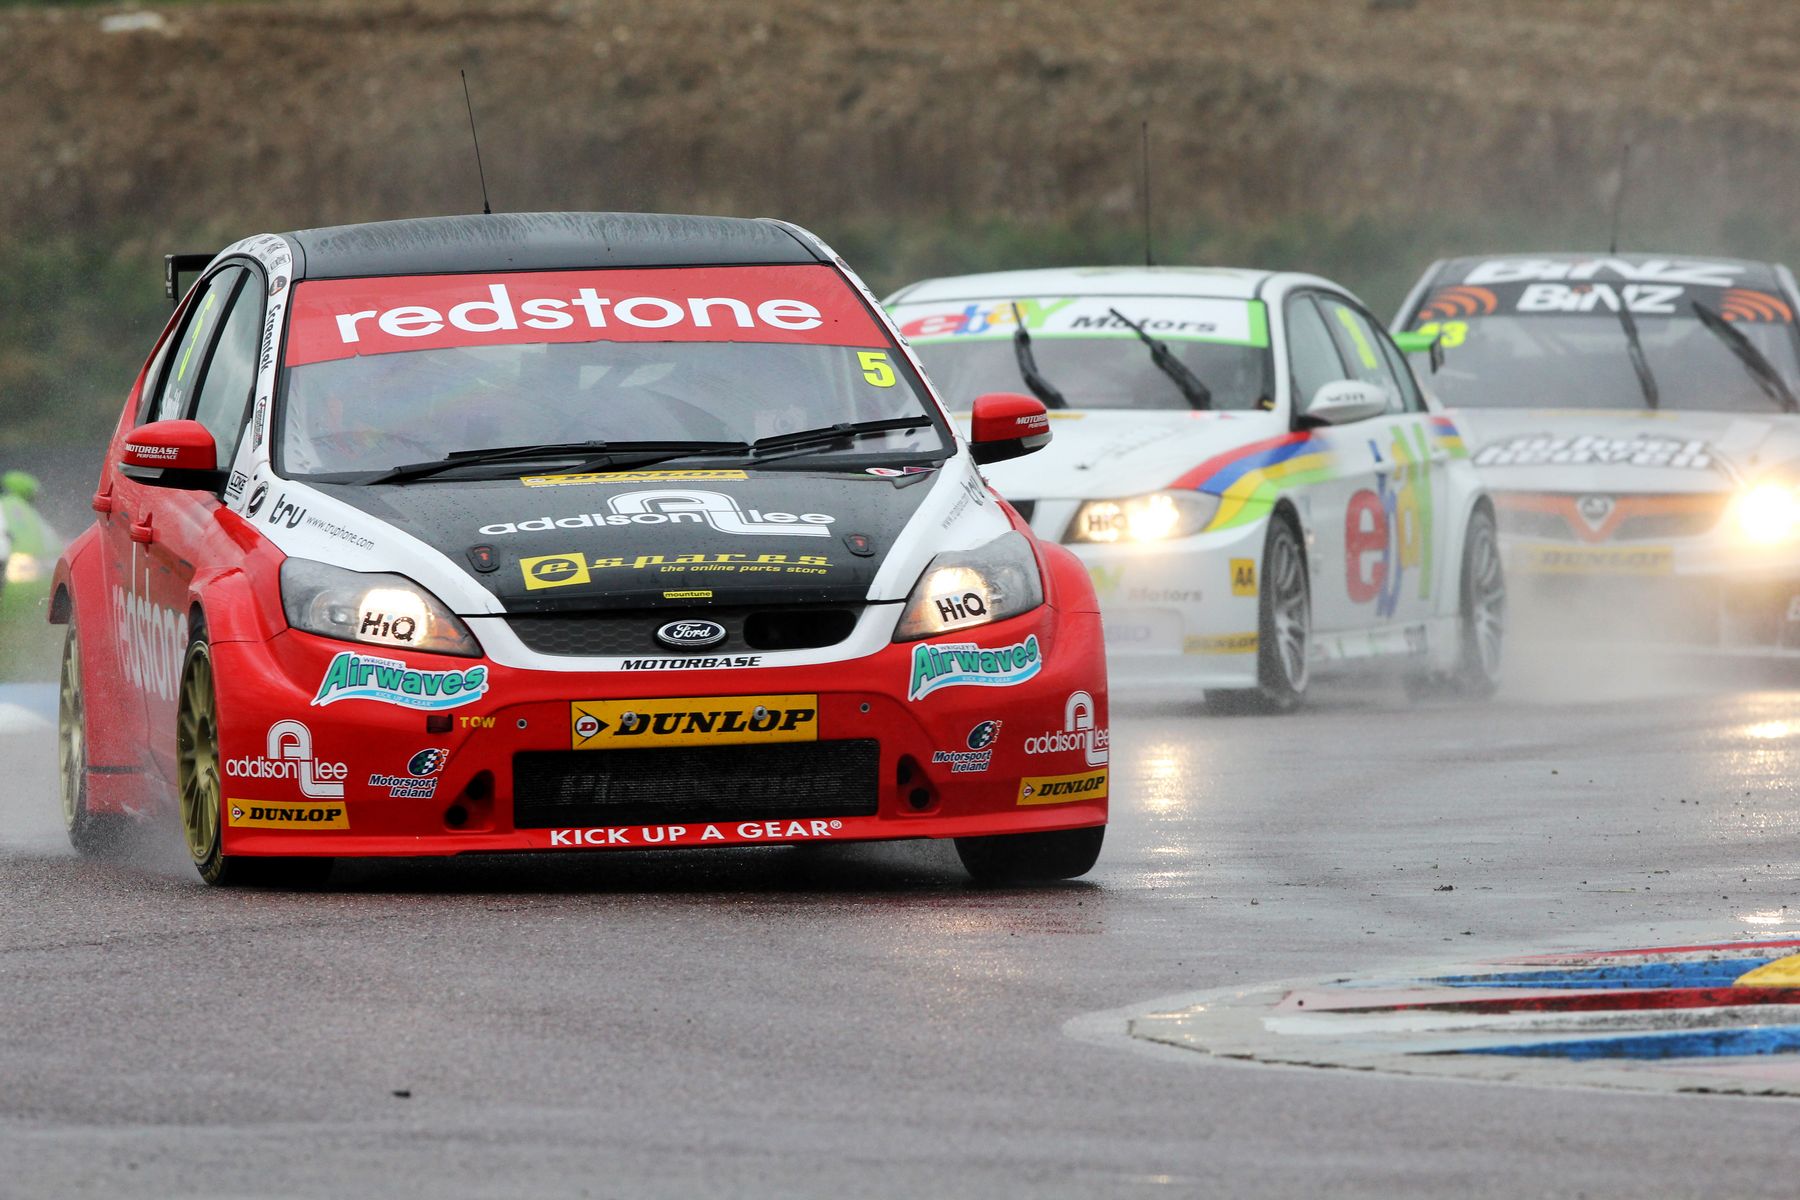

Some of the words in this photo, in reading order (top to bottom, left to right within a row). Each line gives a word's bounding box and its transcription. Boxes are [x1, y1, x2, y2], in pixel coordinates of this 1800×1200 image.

[1516, 283, 1686, 313] BiNZ
[335, 284, 823, 344] redstone
[1069, 309, 1217, 333] Motors
[857, 351, 896, 388] 5
[125, 443, 179, 455] MOTORBASE
[565, 470, 742, 480] DUNLOP
[478, 508, 704, 535] addison
[747, 509, 835, 524] lee
[660, 564, 676, 573] the
[680, 564, 735, 574] online
[739, 564, 782, 575] parts
[787, 565, 827, 575] store
[1235, 566, 1254, 586] AA
[664, 590, 711, 599] mountune
[936, 592, 987, 622] HiQ
[360, 612, 416, 642] HiQ
[672, 622, 712, 640] Ford
[363, 657, 403, 669] WRIGLEY'S
[620, 655, 762, 670] MOTORBASE
[911, 636, 1039, 698] Airwaves
[317, 653, 485, 701] Airwaves
[459, 717, 496, 729] TOW
[613, 708, 815, 736] DUNLOP
[1024, 729, 1086, 755] addison
[933, 751, 992, 763] Motorsport
[952, 761, 988, 773] Ireland
[225, 757, 298, 780] addison
[315, 757, 348, 781] lee
[370, 775, 438, 789] Motorsport
[391, 786, 433, 799] Ireland
[1037, 776, 1106, 798] DUNLOP
[249, 806, 342, 822] DUNLOP
[549, 829, 632, 847] KICK
[641, 827, 687, 844] UP
[700, 824, 726, 840] A
